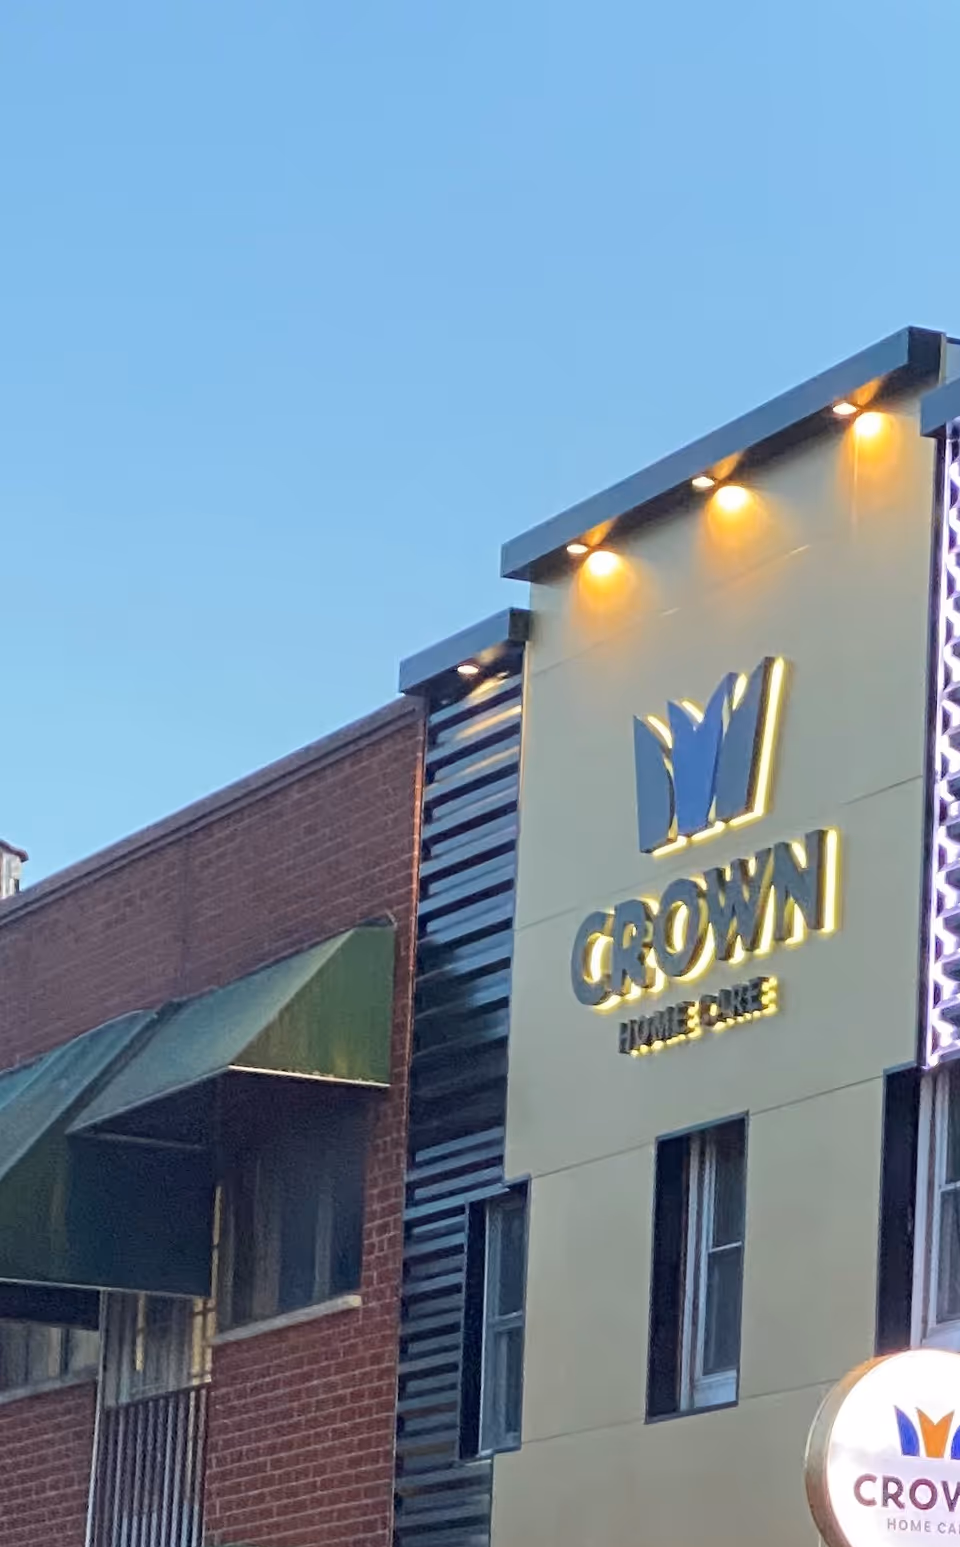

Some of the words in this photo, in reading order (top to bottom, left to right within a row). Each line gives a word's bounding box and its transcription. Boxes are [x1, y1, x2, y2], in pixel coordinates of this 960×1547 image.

[571, 828, 837, 1010] CROWN
[619, 1001, 700, 1057] HOME
[700, 976, 777, 1029] CARE
[886, 1517, 932, 1533] HOME
